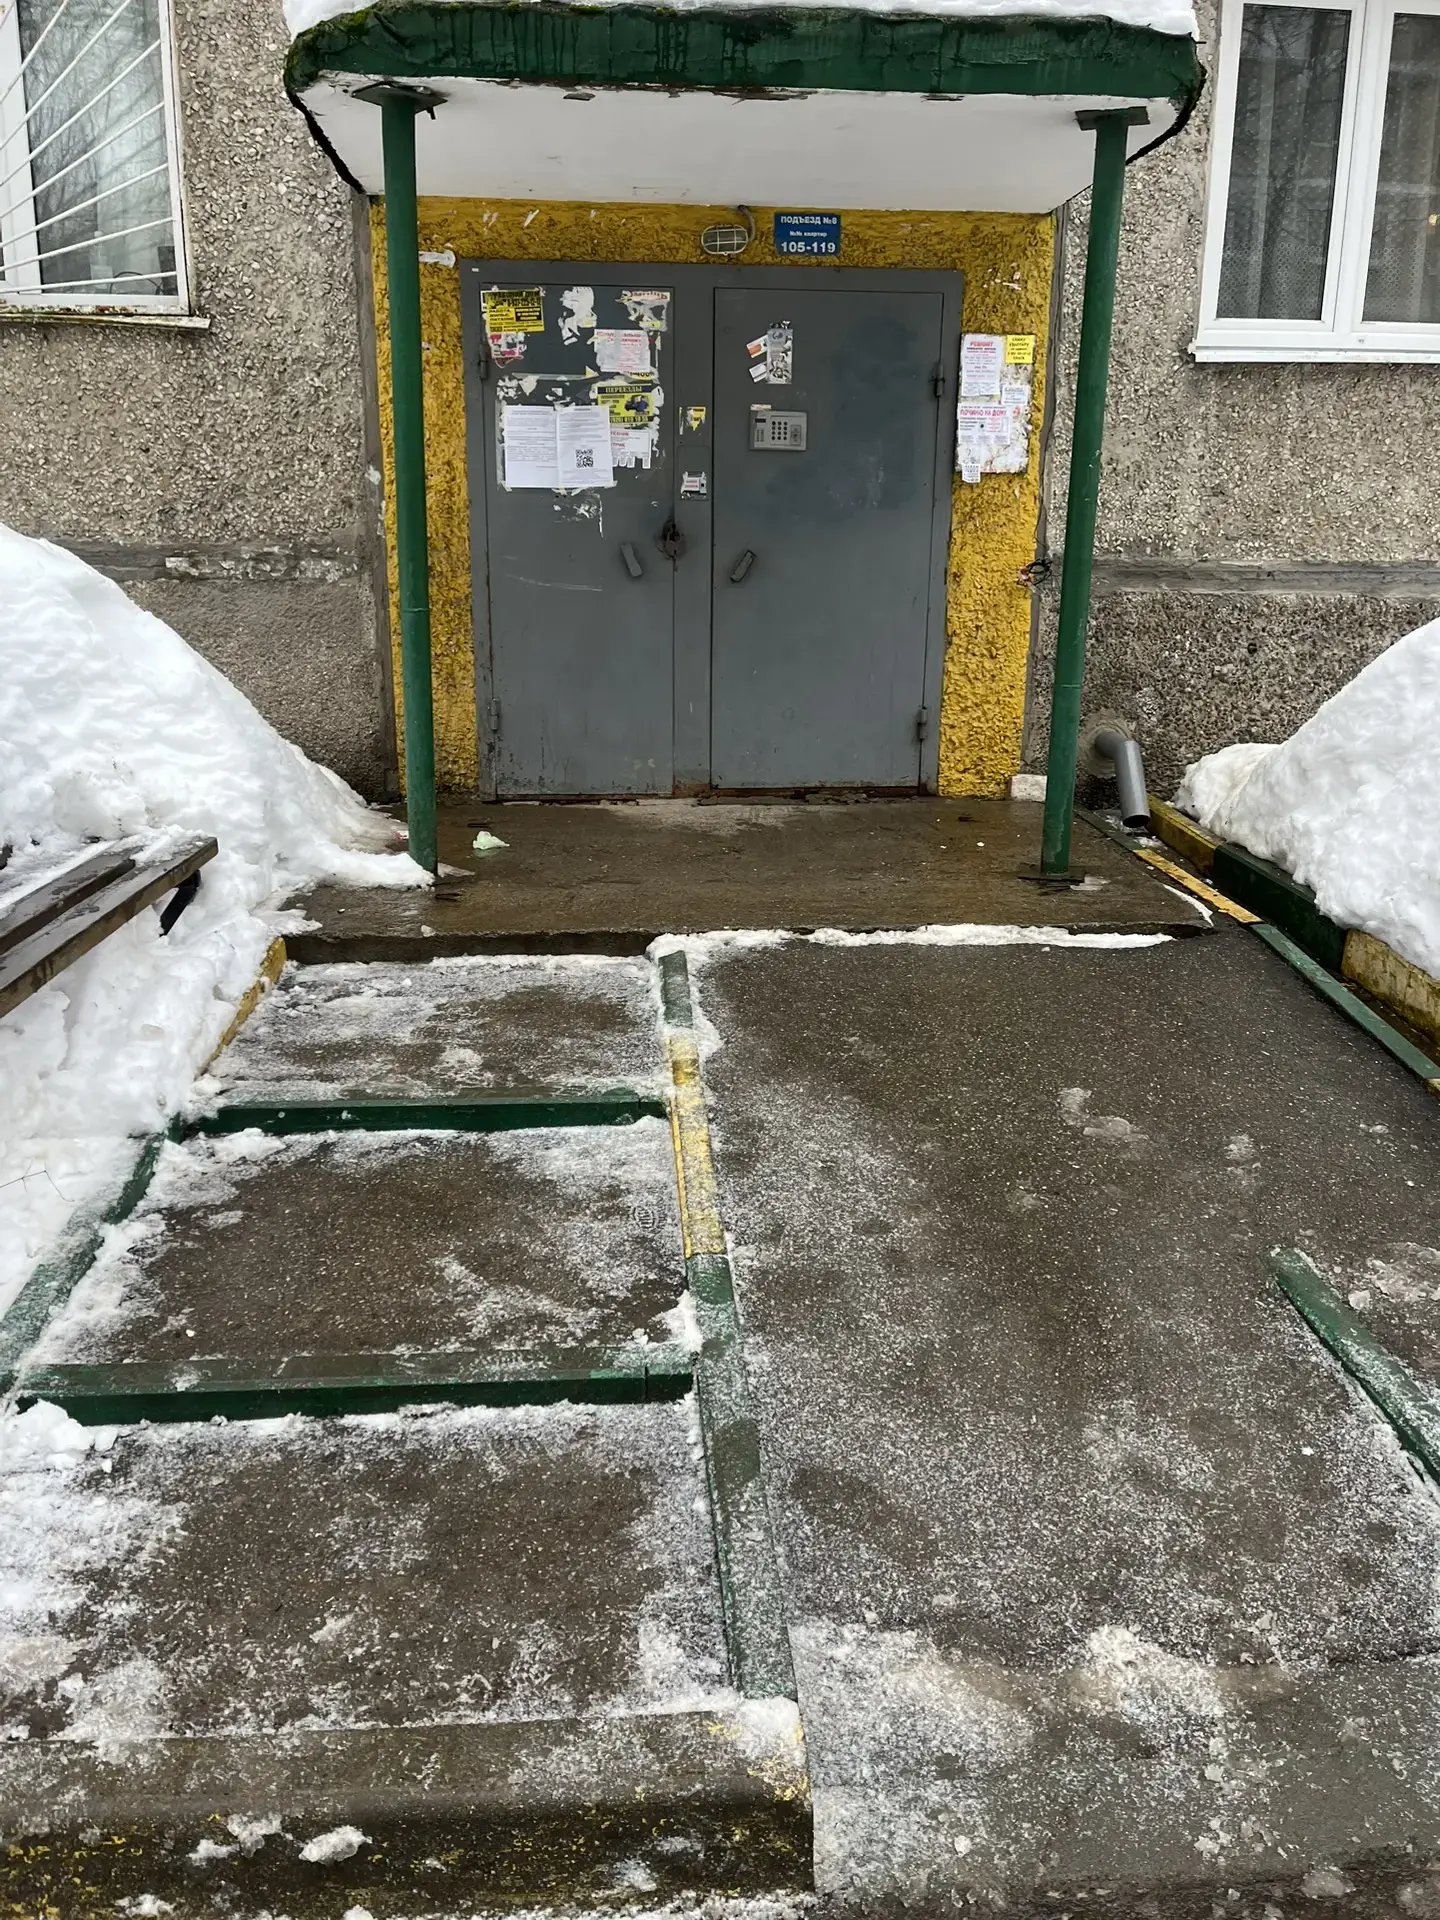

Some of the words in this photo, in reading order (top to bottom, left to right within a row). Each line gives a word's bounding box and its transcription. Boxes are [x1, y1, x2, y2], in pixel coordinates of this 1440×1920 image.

[780, 215, 822, 225] ПОДЪЕЗД
[823, 216, 838, 225] №8
[781, 241, 836, 253] 105-119
